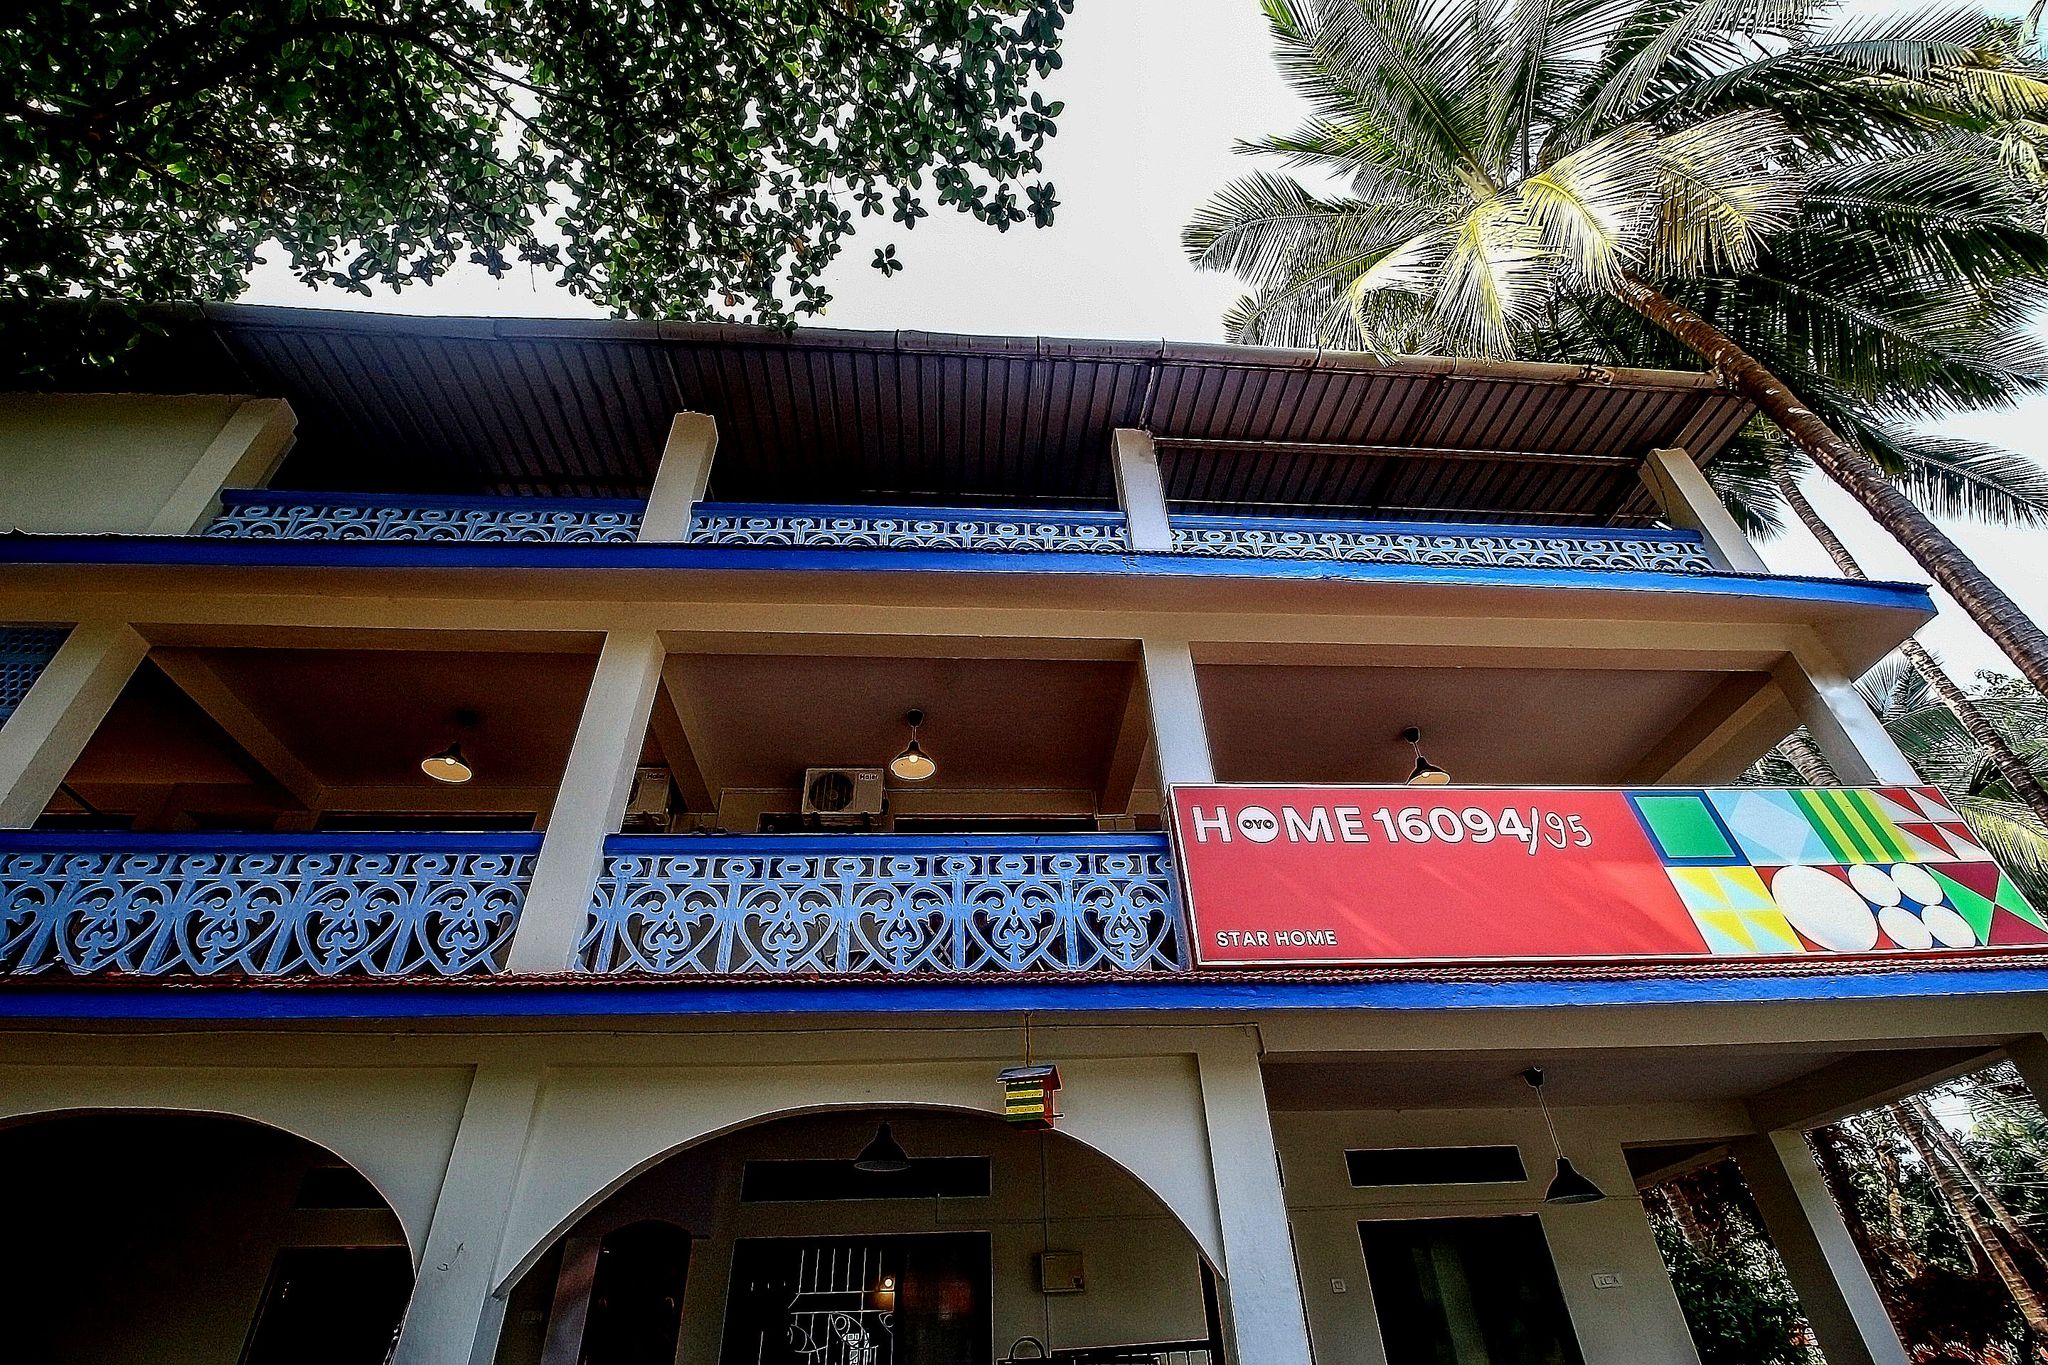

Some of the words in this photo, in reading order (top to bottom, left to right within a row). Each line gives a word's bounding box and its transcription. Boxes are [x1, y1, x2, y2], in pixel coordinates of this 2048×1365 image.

[1242, 819, 1274, 829] OYO
[1216, 930, 1269, 947] STAR
[1274, 930, 1338, 946] HOME
